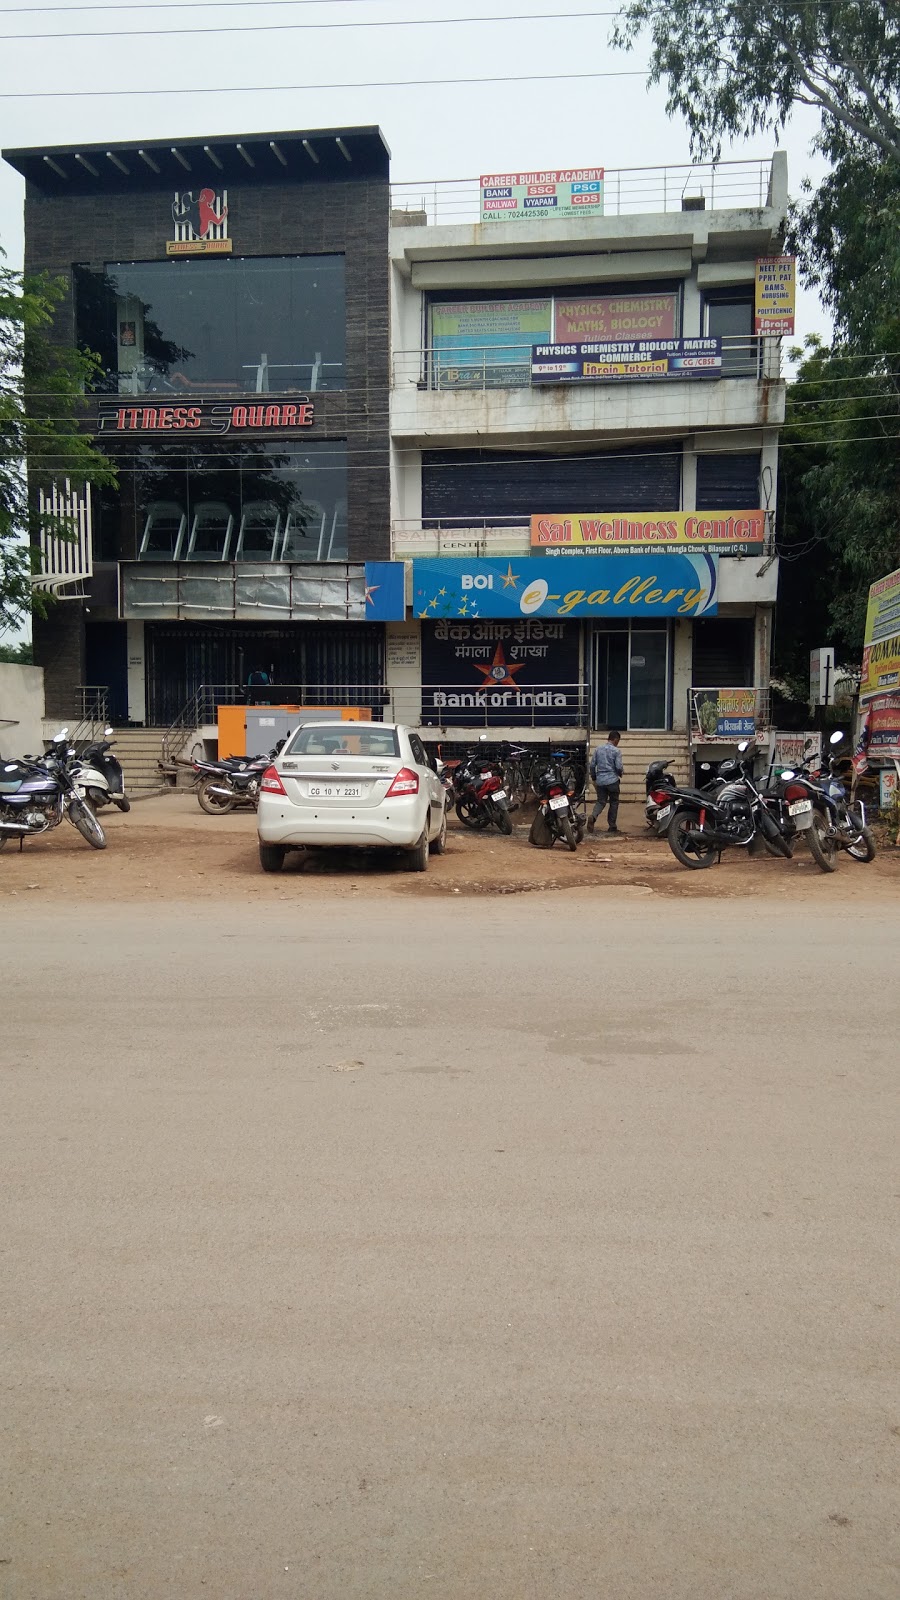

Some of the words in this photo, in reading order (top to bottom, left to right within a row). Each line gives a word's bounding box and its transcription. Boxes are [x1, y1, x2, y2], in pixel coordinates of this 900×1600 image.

[482, 175, 517, 187] CAREER
[520, 172, 557, 184] BUILDER
[559, 170, 602, 182] ACADEMY
[486, 188, 510, 197] BANK
[530, 186, 554, 194] SSC
[574, 183, 598, 192] PSC
[486, 200, 516, 209] RAILWAY
[526, 198, 554, 206] VYAPAM
[574, 195, 598, 204] CDS
[508, 210, 548, 219] 7024425360
[558, 304, 605, 317] PHYSICS,
[608, 299, 672, 313] CHEMISTRY,
[567, 319, 607, 332] MATHS,
[610, 316, 664, 330] BIOLOGY
[615, 332, 653, 340] Classes
[536, 345, 577, 356] PHYSICS
[581, 342, 635, 354] CHEMISTRY
[638, 341, 680, 352] BIOLOGY
[684, 339, 717, 349] MATHS
[600, 352, 652, 363] COMMERCE
[586, 364, 619, 374] iBrain
[624, 362, 665, 373] Tutorial
[98, 408, 202, 429] FITNESS
[211, 404, 314, 434] SQUARE
[538, 520, 572, 542] Sai
[579, 518, 678, 541] Wellness
[684, 516, 762, 539] Center
[545, 548, 560, 556] Singh
[561, 547, 584, 556] Complex,
[598, 546, 612, 554] Floor,
[651, 546, 666, 554] India,
[667, 546, 687, 554] Mangla
[708, 545, 730, 553] Bilaspur
[731, 545, 748, 553] (C.G.)
[462, 574, 493, 590] BOI
[524, 576, 708, 614] e-gallery
[434, 619, 470, 640] बैंक
[514, 619, 566, 643] इंडिया
[455, 644, 492, 658] मंगला
[510, 645, 548, 660] शाखा
[433, 692, 488, 707] Bank
[490, 692, 513, 707] of
[516, 692, 566, 707] India
